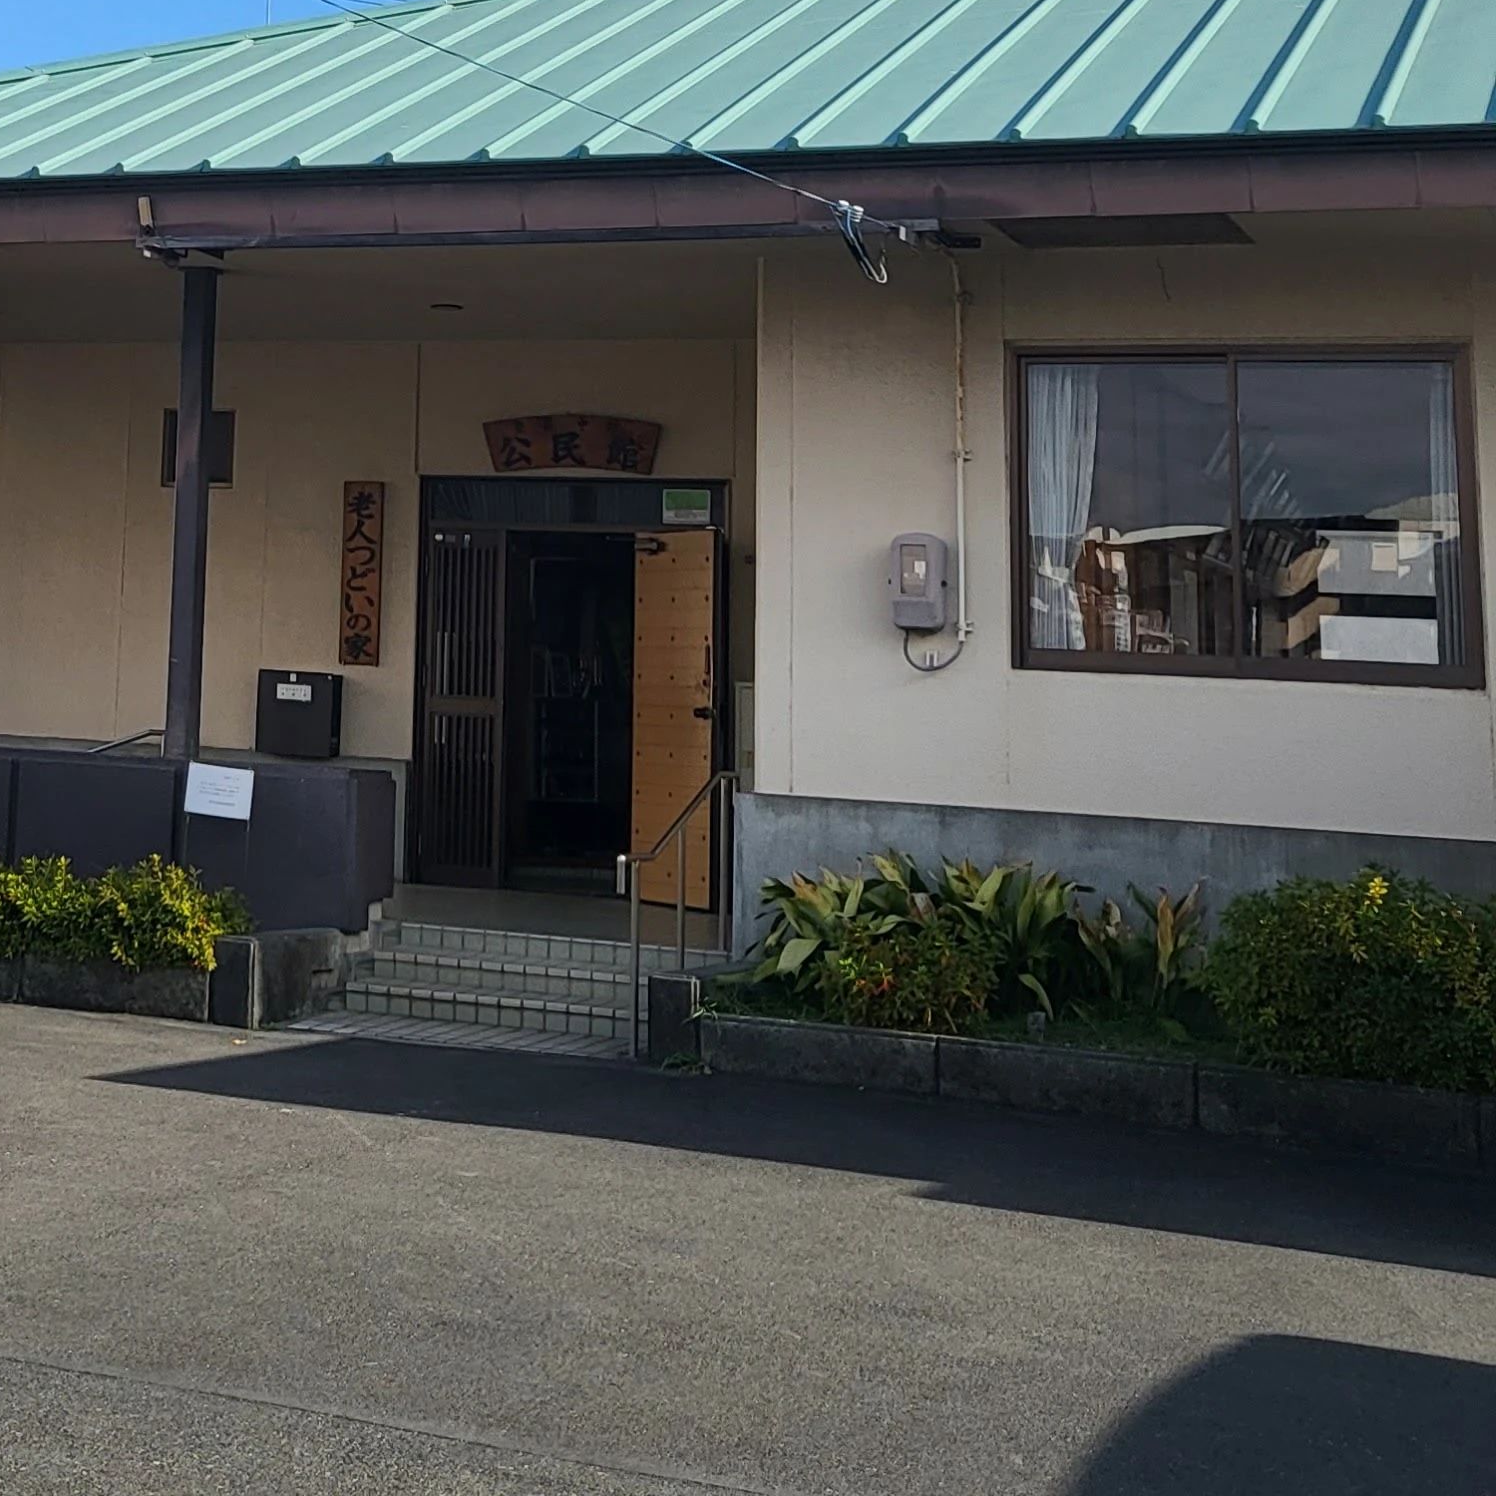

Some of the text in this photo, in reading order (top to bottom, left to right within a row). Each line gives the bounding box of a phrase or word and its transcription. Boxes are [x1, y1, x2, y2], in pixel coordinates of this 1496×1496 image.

[343, 490, 378, 661] 老人つどいの家
